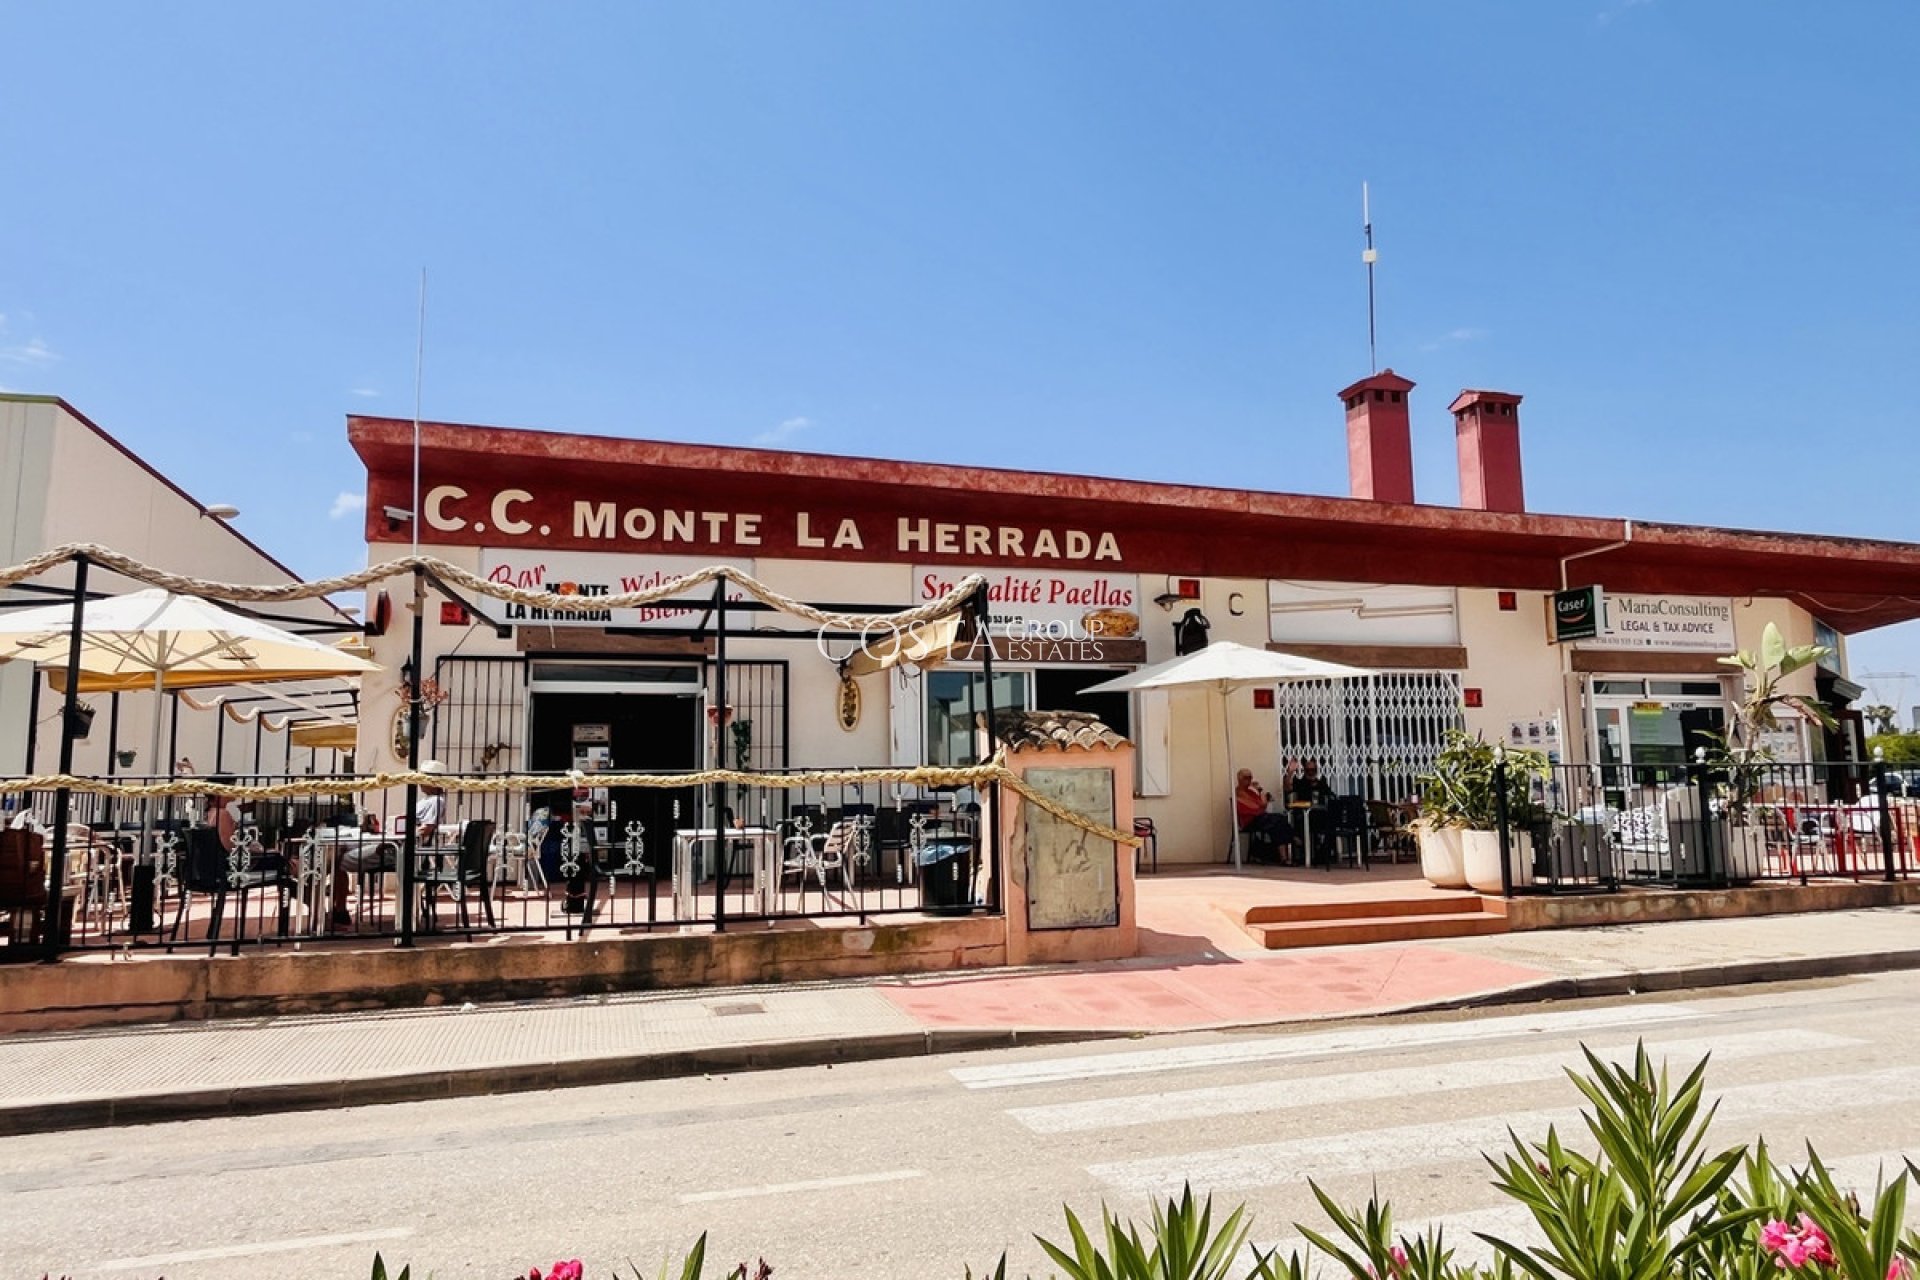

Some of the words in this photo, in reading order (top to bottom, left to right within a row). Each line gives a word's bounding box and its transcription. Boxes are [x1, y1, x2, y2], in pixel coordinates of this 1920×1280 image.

[424, 485, 550, 536] C.C.
[573, 501, 762, 545] MONTE
[797, 512, 864, 549] LA
[898, 518, 1123, 561] HERRADA
[488, 565, 546, 589] Bar
[1047, 579, 1133, 607] Paellas
[1558, 598, 1585, 613] Caser
[1618, 598, 1729, 621] MariaConsulting
[1620, 621, 1650, 633] LEGAL
[1653, 622, 1660, 633] &
[1663, 622, 1680, 633] TAX
[1682, 623, 1715, 634] ADVICE
